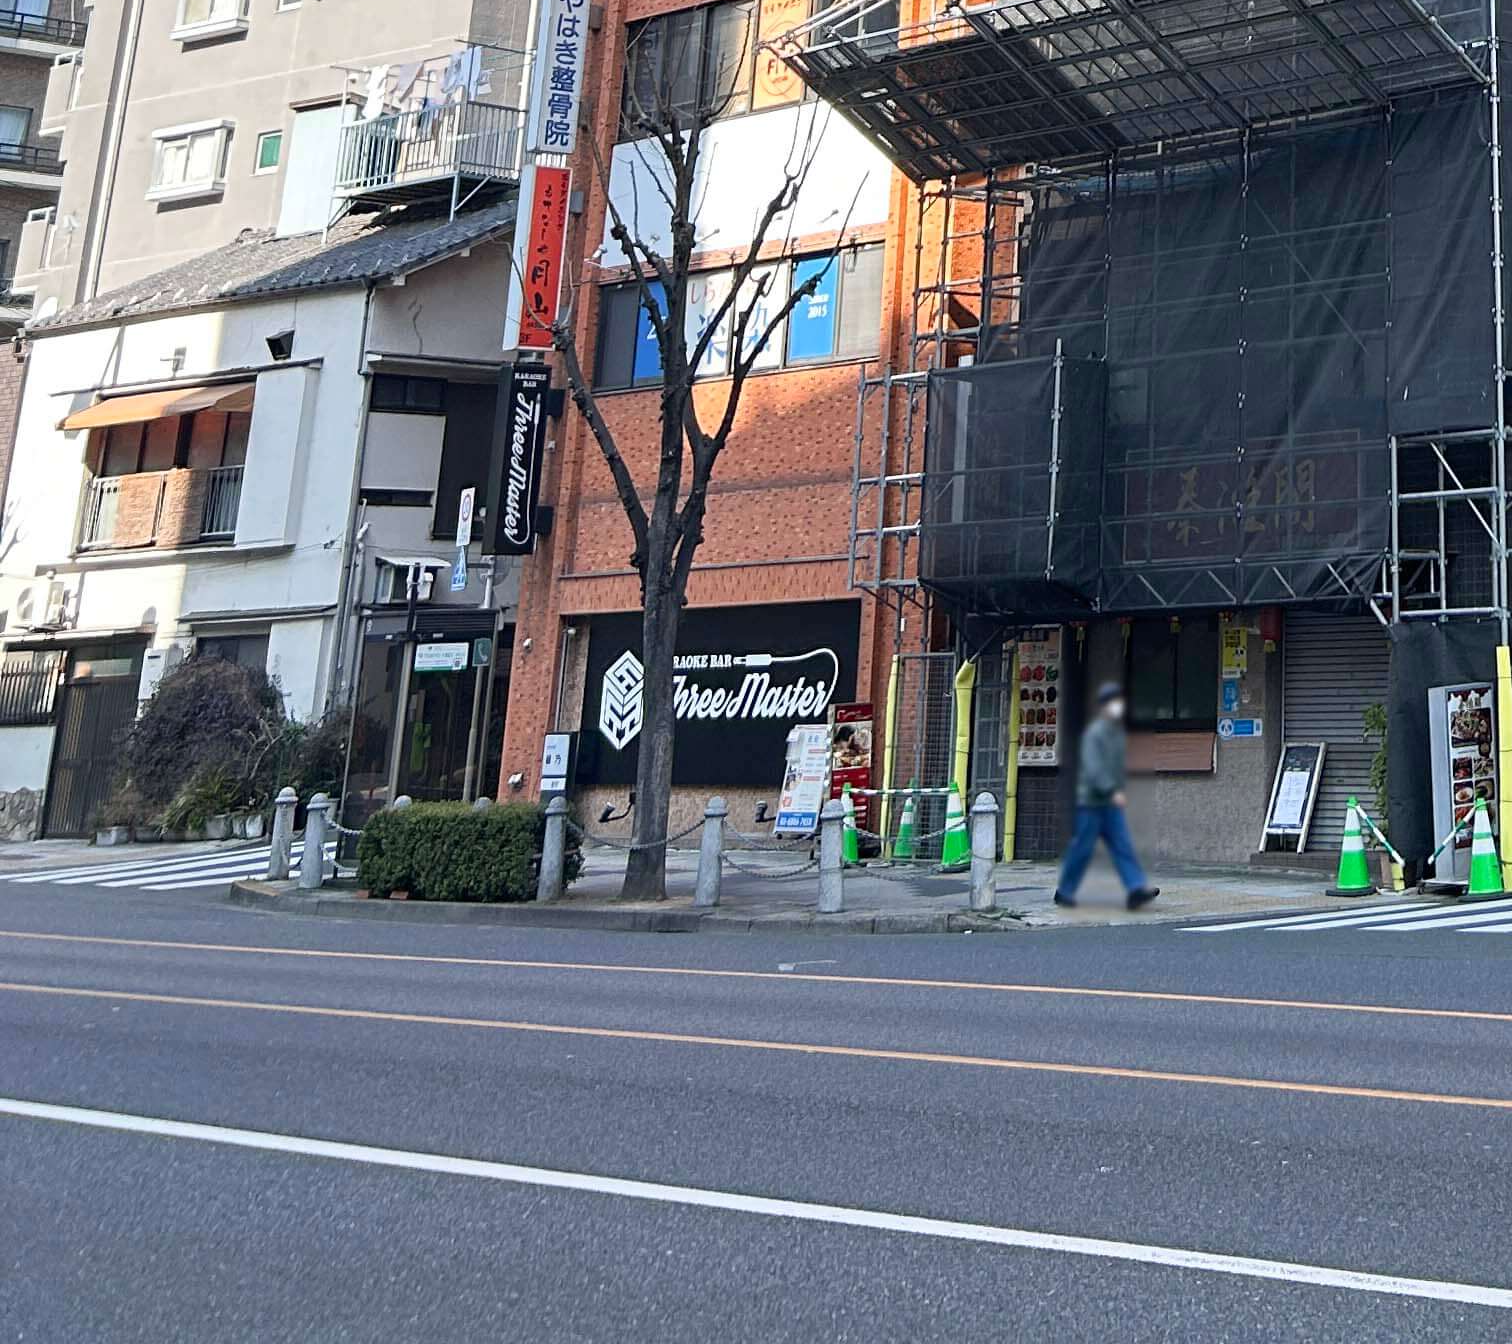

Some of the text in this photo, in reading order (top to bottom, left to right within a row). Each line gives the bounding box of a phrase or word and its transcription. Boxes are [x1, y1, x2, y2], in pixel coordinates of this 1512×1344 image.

[523, 380, 537, 388] BAR
[504, 392, 534, 538] Three Master
[710, 654, 732, 668] BAR
[726, 672, 827, 719] Master
